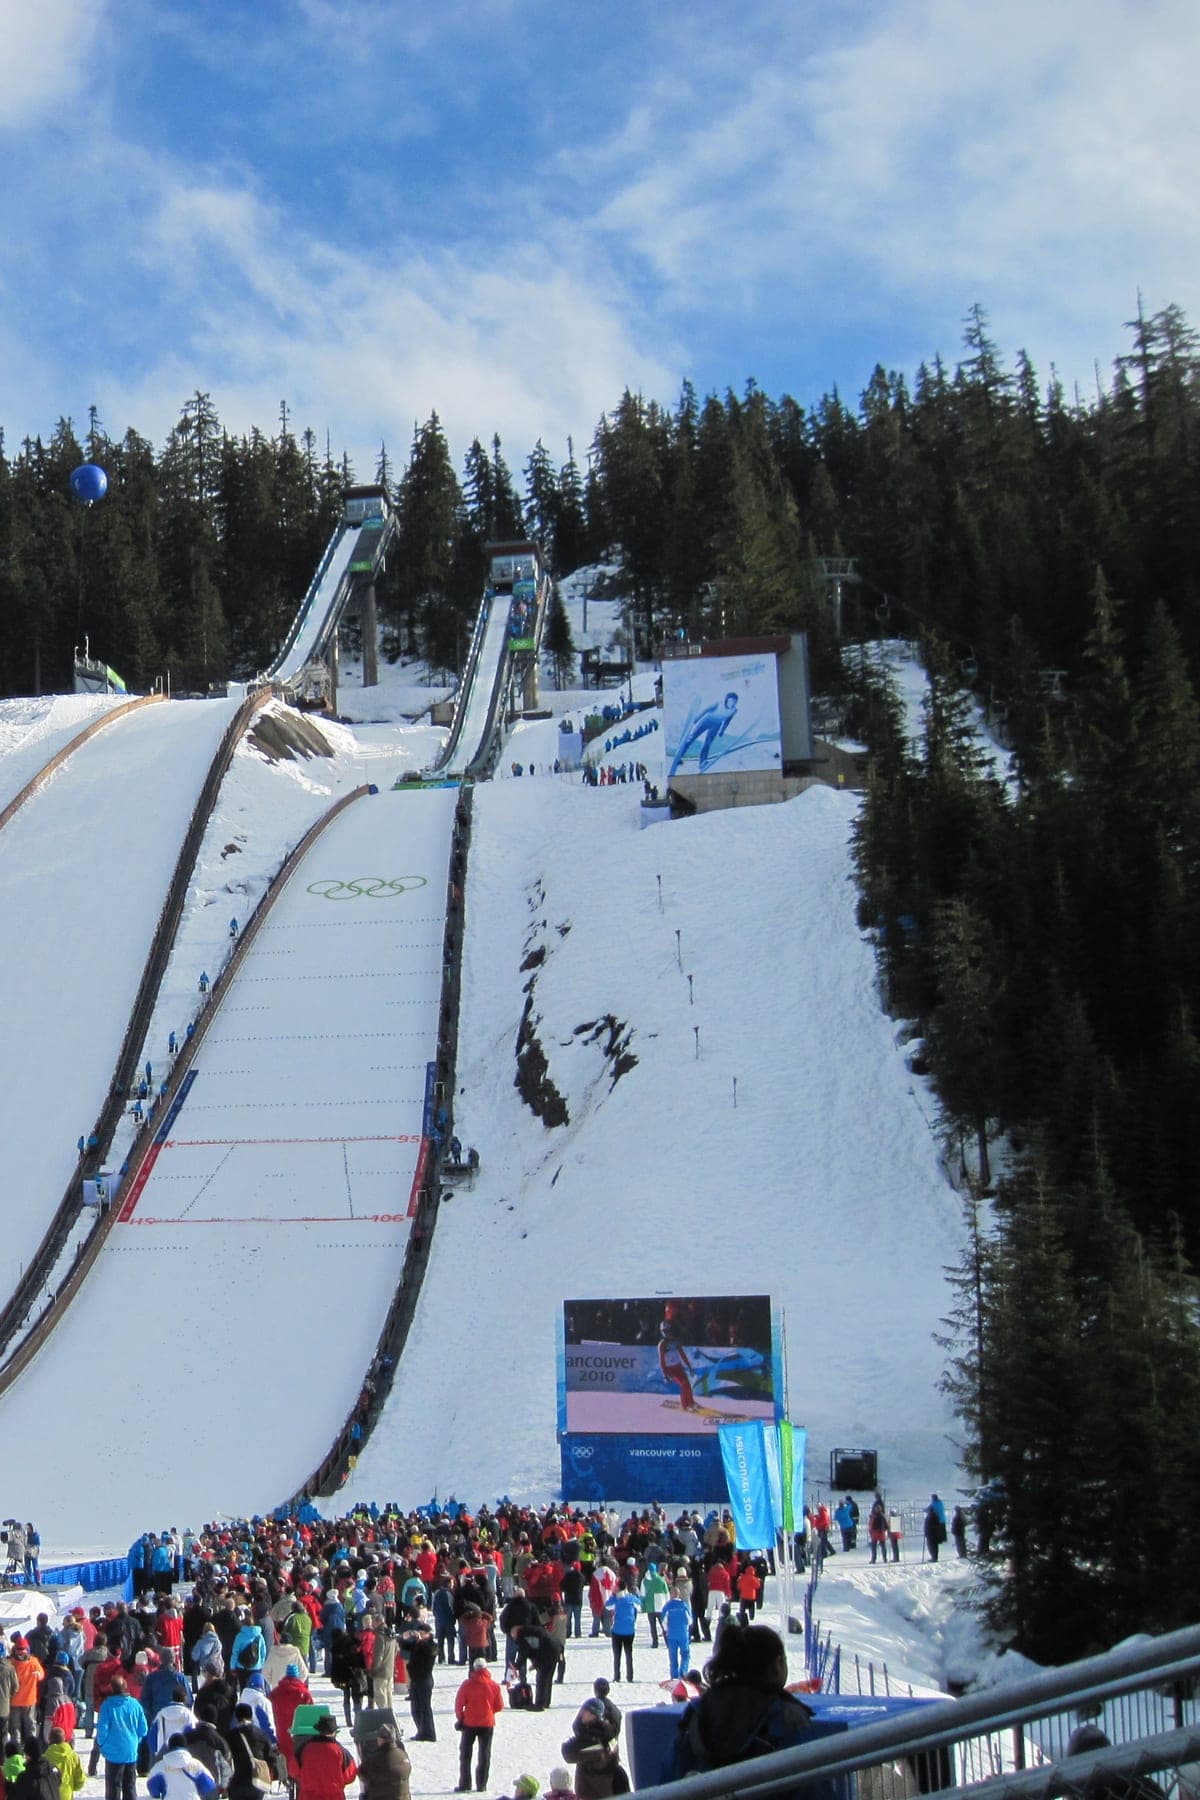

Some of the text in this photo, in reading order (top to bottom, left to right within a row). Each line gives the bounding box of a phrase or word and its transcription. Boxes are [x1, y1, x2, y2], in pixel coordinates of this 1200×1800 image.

[164, 1134, 420, 1149] K 95
[372, 1214, 405, 1223] 106
[579, 1370, 616, 1382] 2010
[629, 1448, 702, 1457] vancouver 2010
